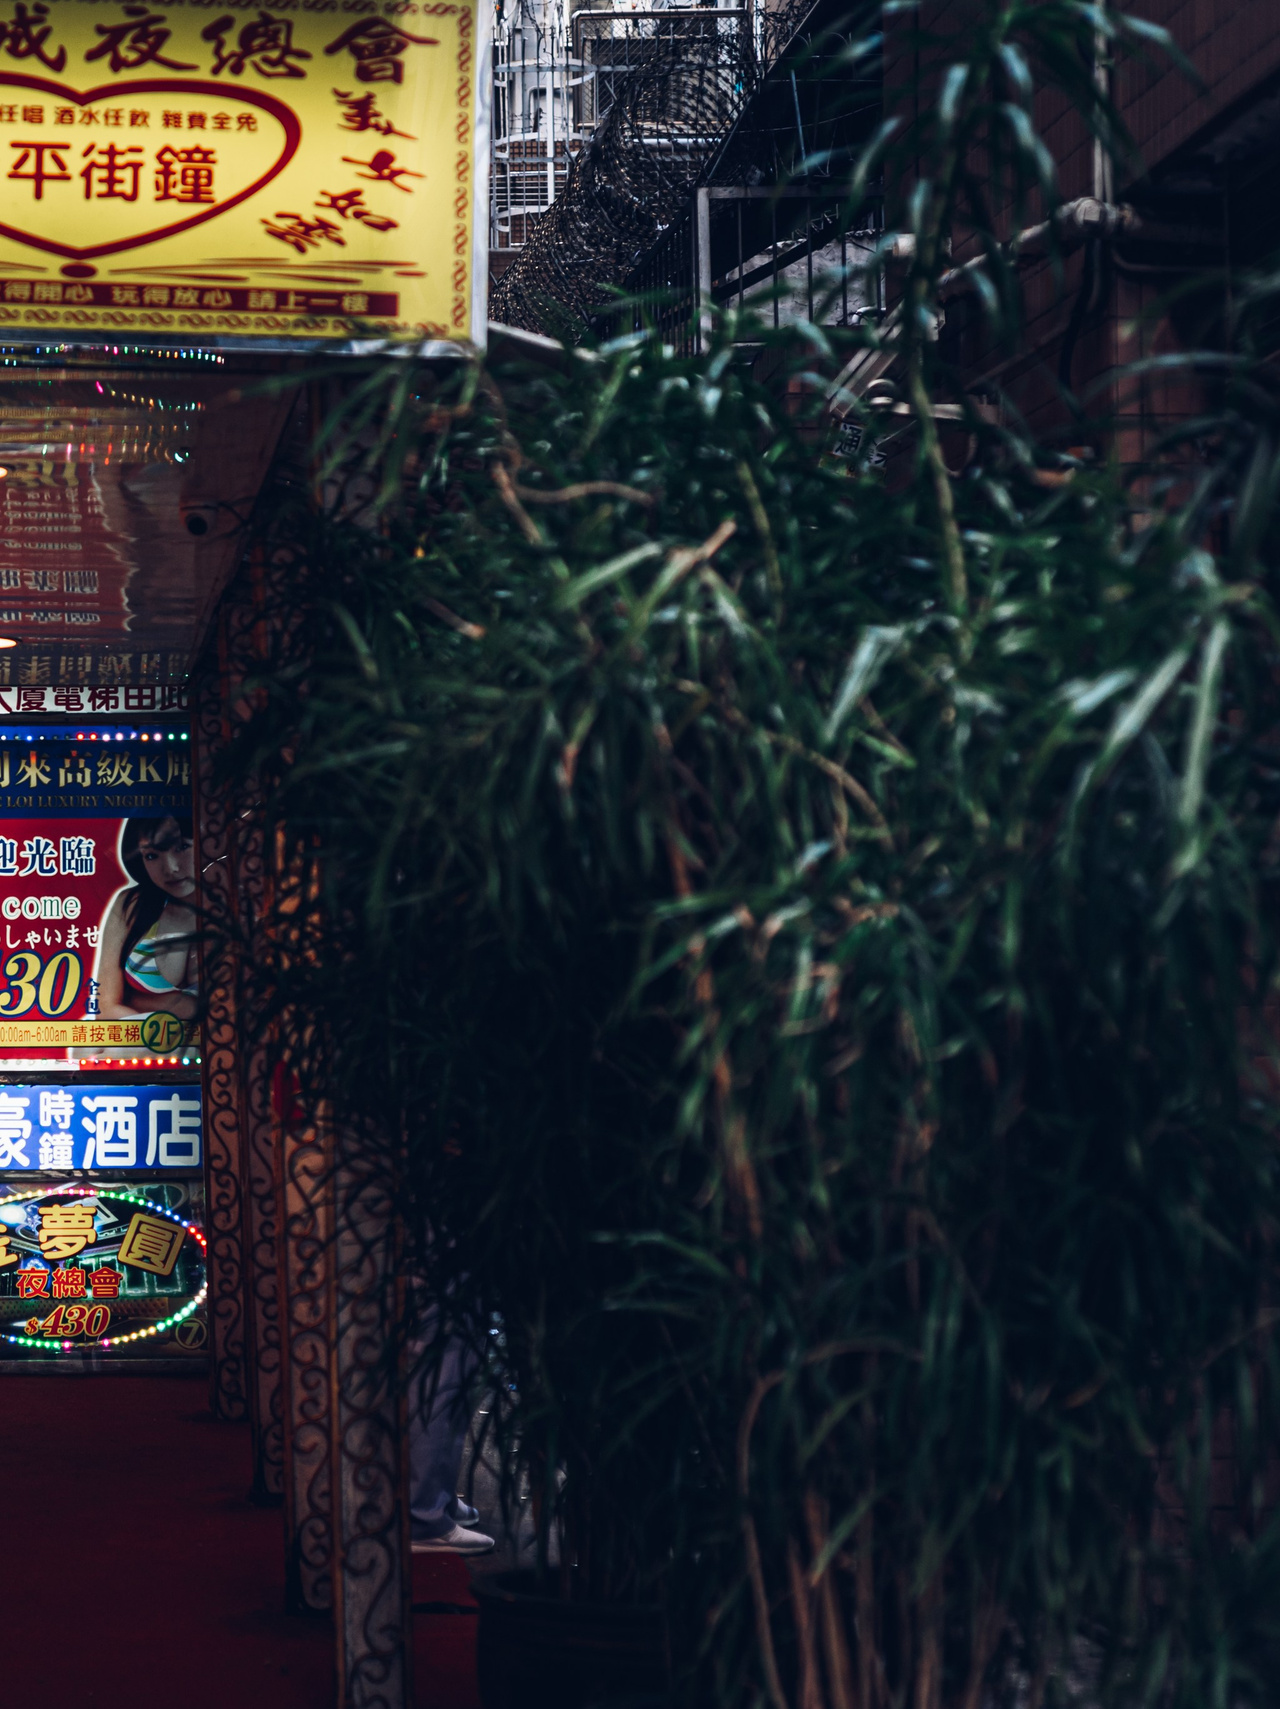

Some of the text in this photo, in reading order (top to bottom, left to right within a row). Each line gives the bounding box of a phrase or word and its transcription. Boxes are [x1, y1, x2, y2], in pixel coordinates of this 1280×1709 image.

[54, 105, 151, 128] 酒水任飲
[161, 109, 258, 132] 雜費全免
[112, 286, 233, 308] 玩得放心
[248, 289, 370, 313] 請上一樓
[7, 796, 35, 808] LOI
[37, 796, 101, 808] LUXURY
[103, 796, 156, 808] NIGHT
[15, 1267, 123, 1299] 夜總會
[25, 1305, 110, 1337] $430
